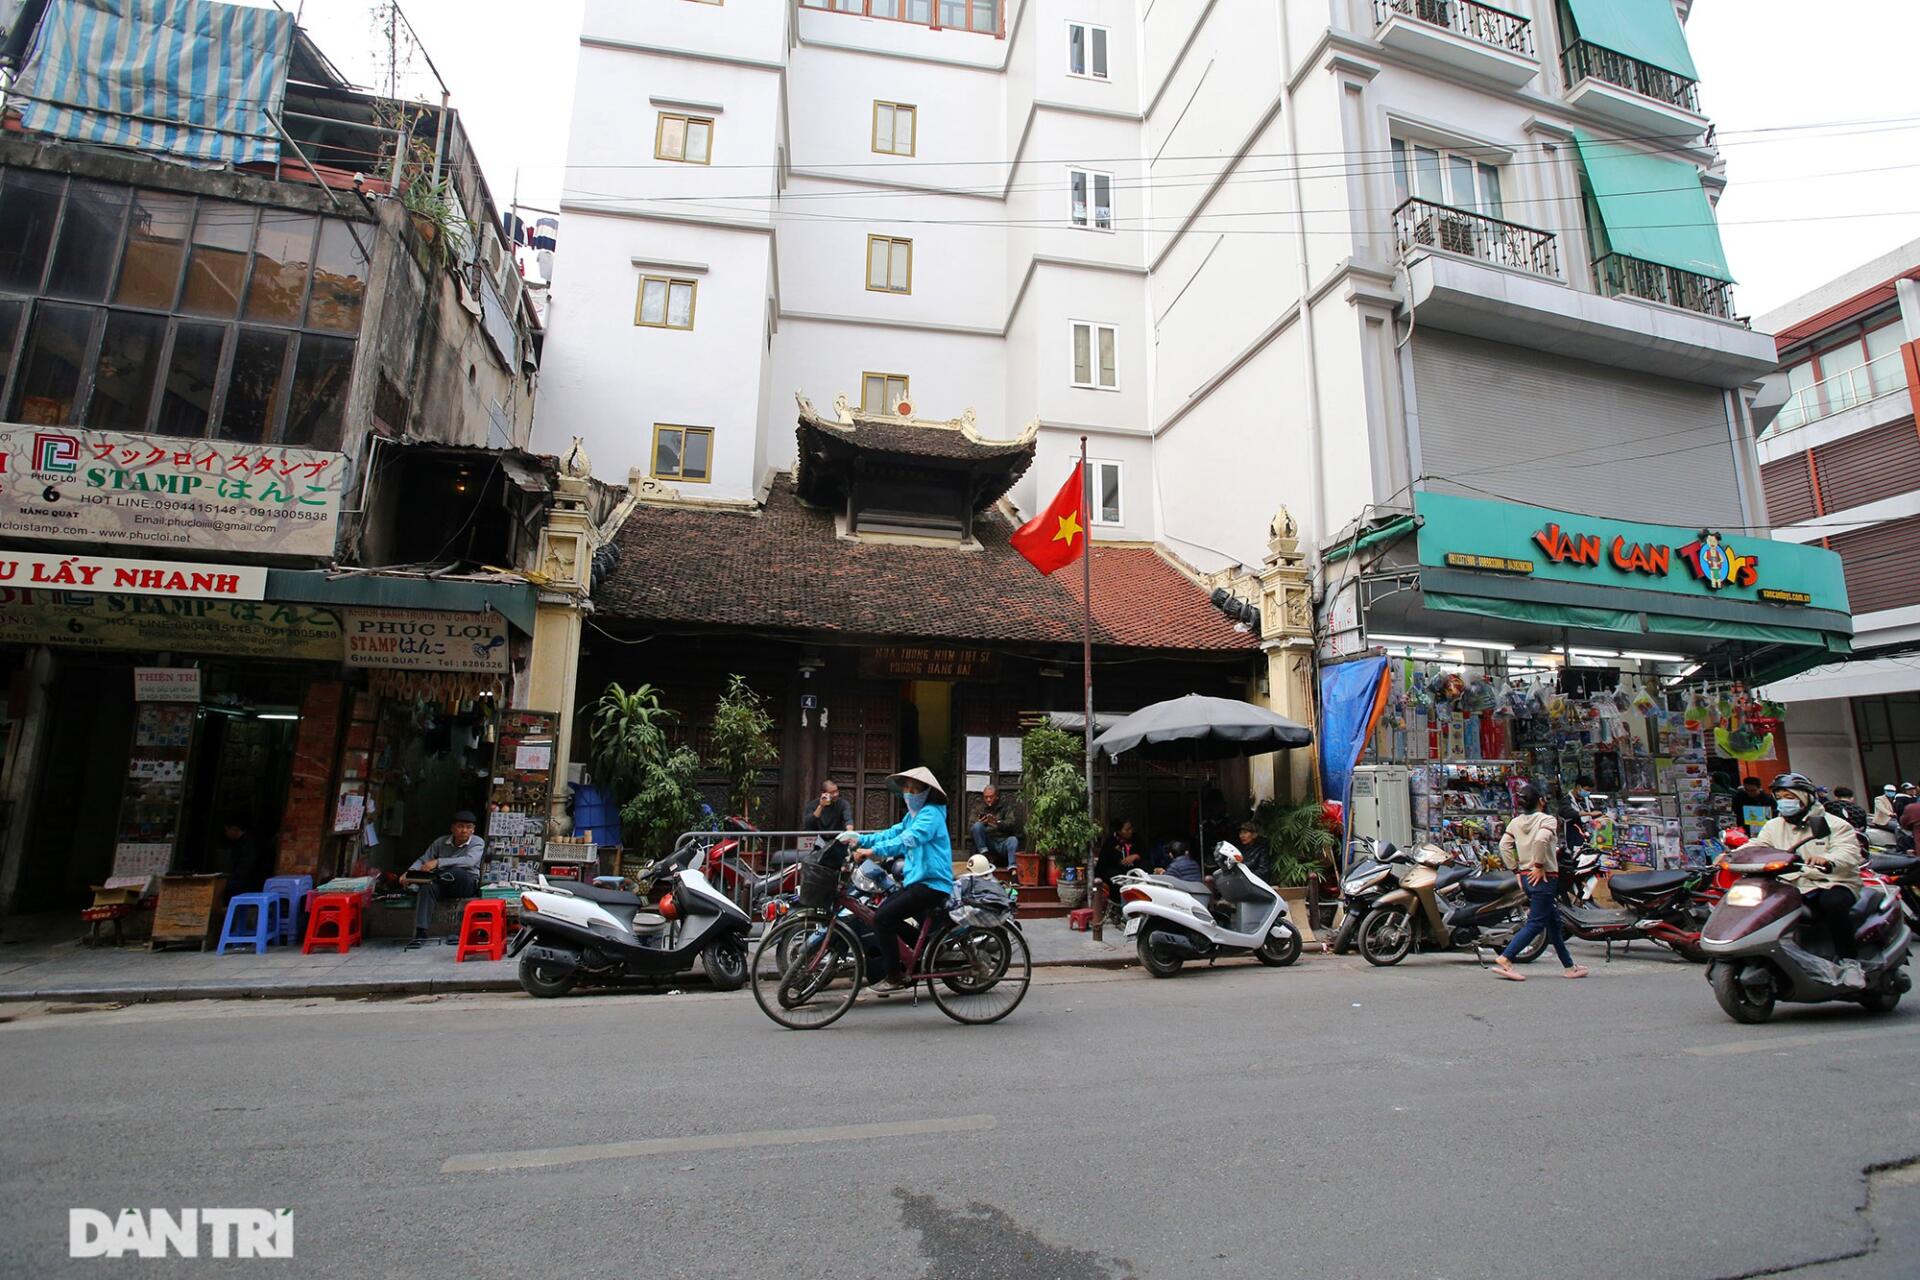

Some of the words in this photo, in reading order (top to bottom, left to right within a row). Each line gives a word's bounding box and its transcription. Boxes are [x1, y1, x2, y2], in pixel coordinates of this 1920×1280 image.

[93, 443, 218, 471] フックロイ
[228, 455, 329, 479] スタンプ
[42, 485, 61, 502] 6
[80, 494, 112, 505] HOT
[250, 507, 328, 521] 0913005838
[99, 529, 191, 543] www.phucloi.net
[1531, 522, 1601, 567] VAN
[1610, 534, 1670, 577] CAN
[30, 557, 103, 585] LẤY
[113, 568, 240, 593] NHANH
[68, 617, 84, 633] 6
[358, 619, 436, 637] PHÚC
[446, 624, 493, 640] LỢI
[351, 635, 398, 653] STAMP
